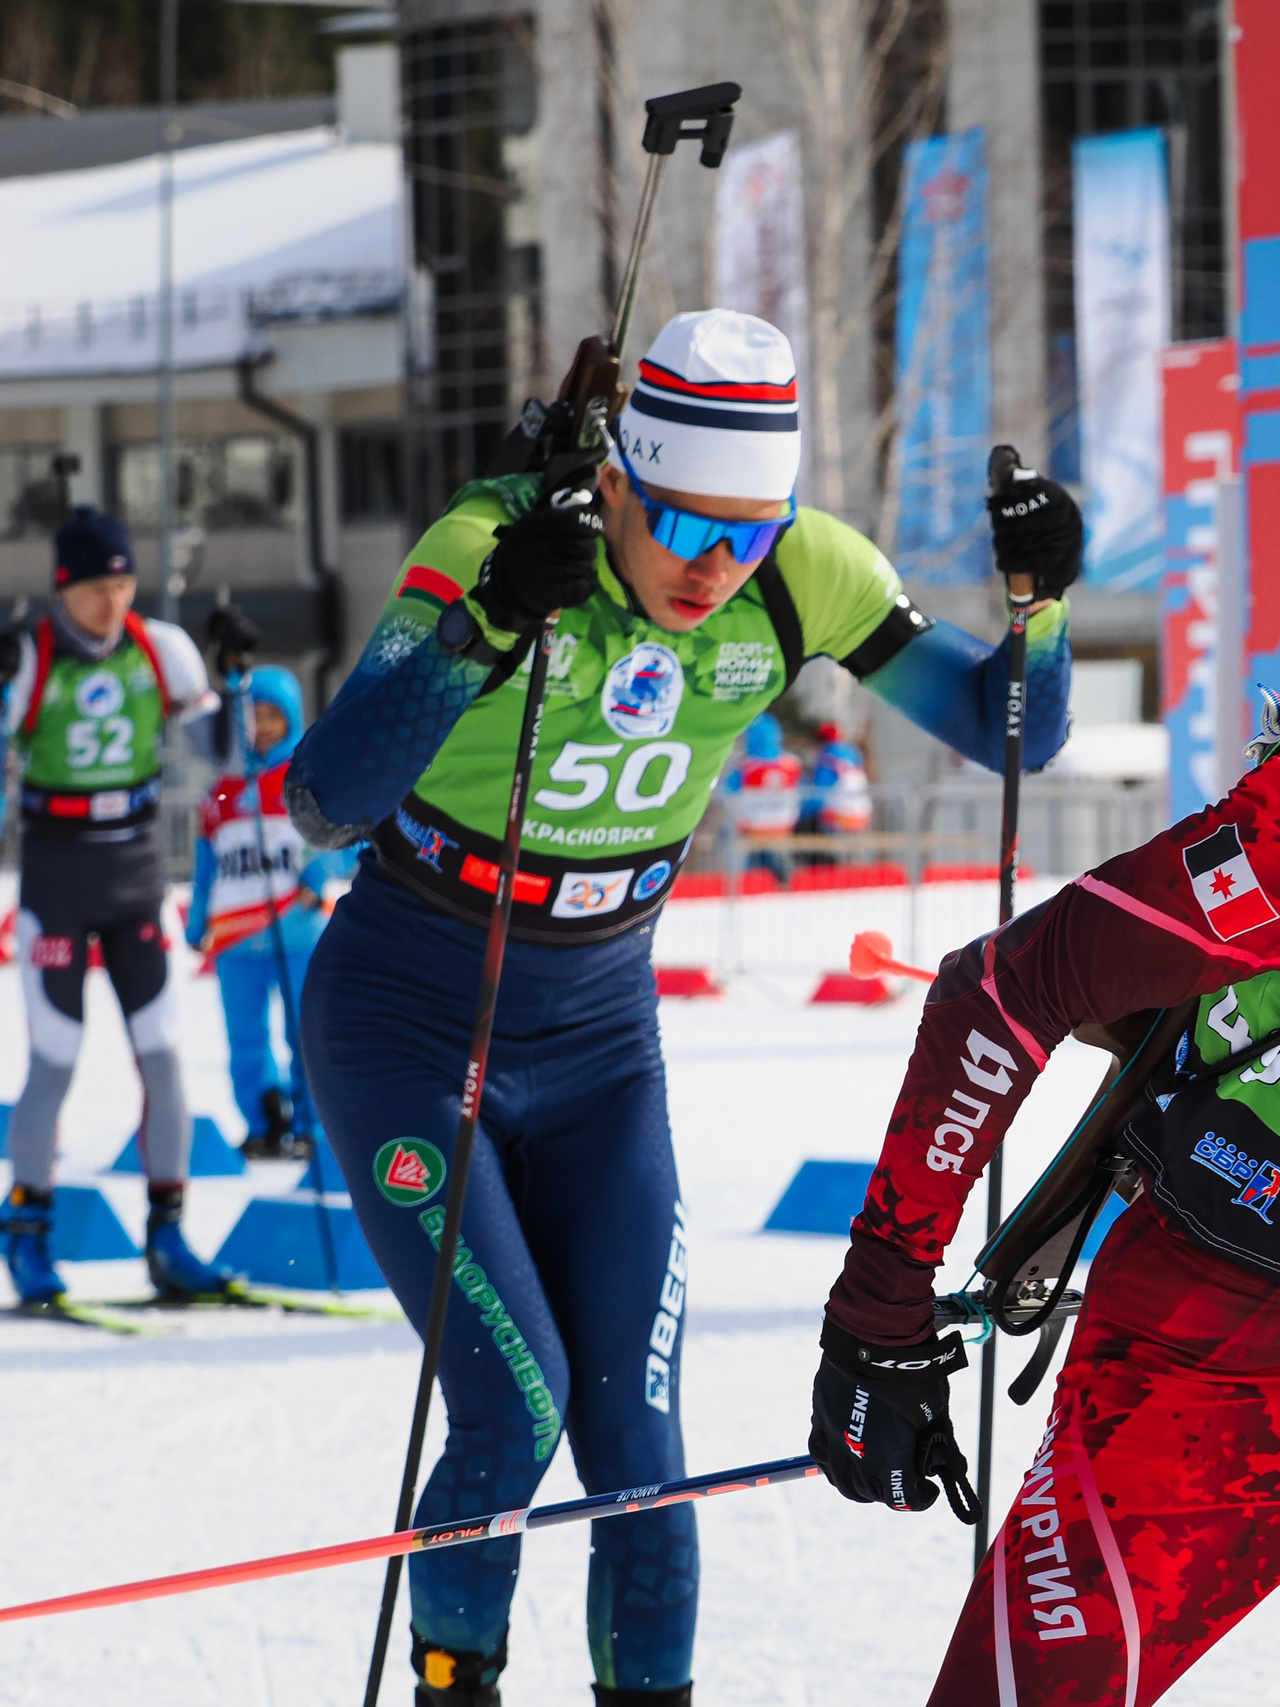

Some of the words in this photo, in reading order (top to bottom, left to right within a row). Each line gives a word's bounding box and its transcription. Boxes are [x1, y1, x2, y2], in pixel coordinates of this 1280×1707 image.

[1001, 491, 1050, 518] MOAX
[1006, 682, 1022, 737] MOAX
[67, 717, 134, 768] 52
[533, 740, 693, 813] 50
[521, 818, 659, 846] КРАСНОЯРСК
[926, 1088, 992, 1175] ПСБ
[1193, 1138, 1255, 1181] СБР
[870, 1346, 957, 1370] PILOT
[843, 1384, 870, 1460] INETIX
[616, 1483, 663, 1503] NANOLITE
[428, 1525, 485, 1544] PILOT
